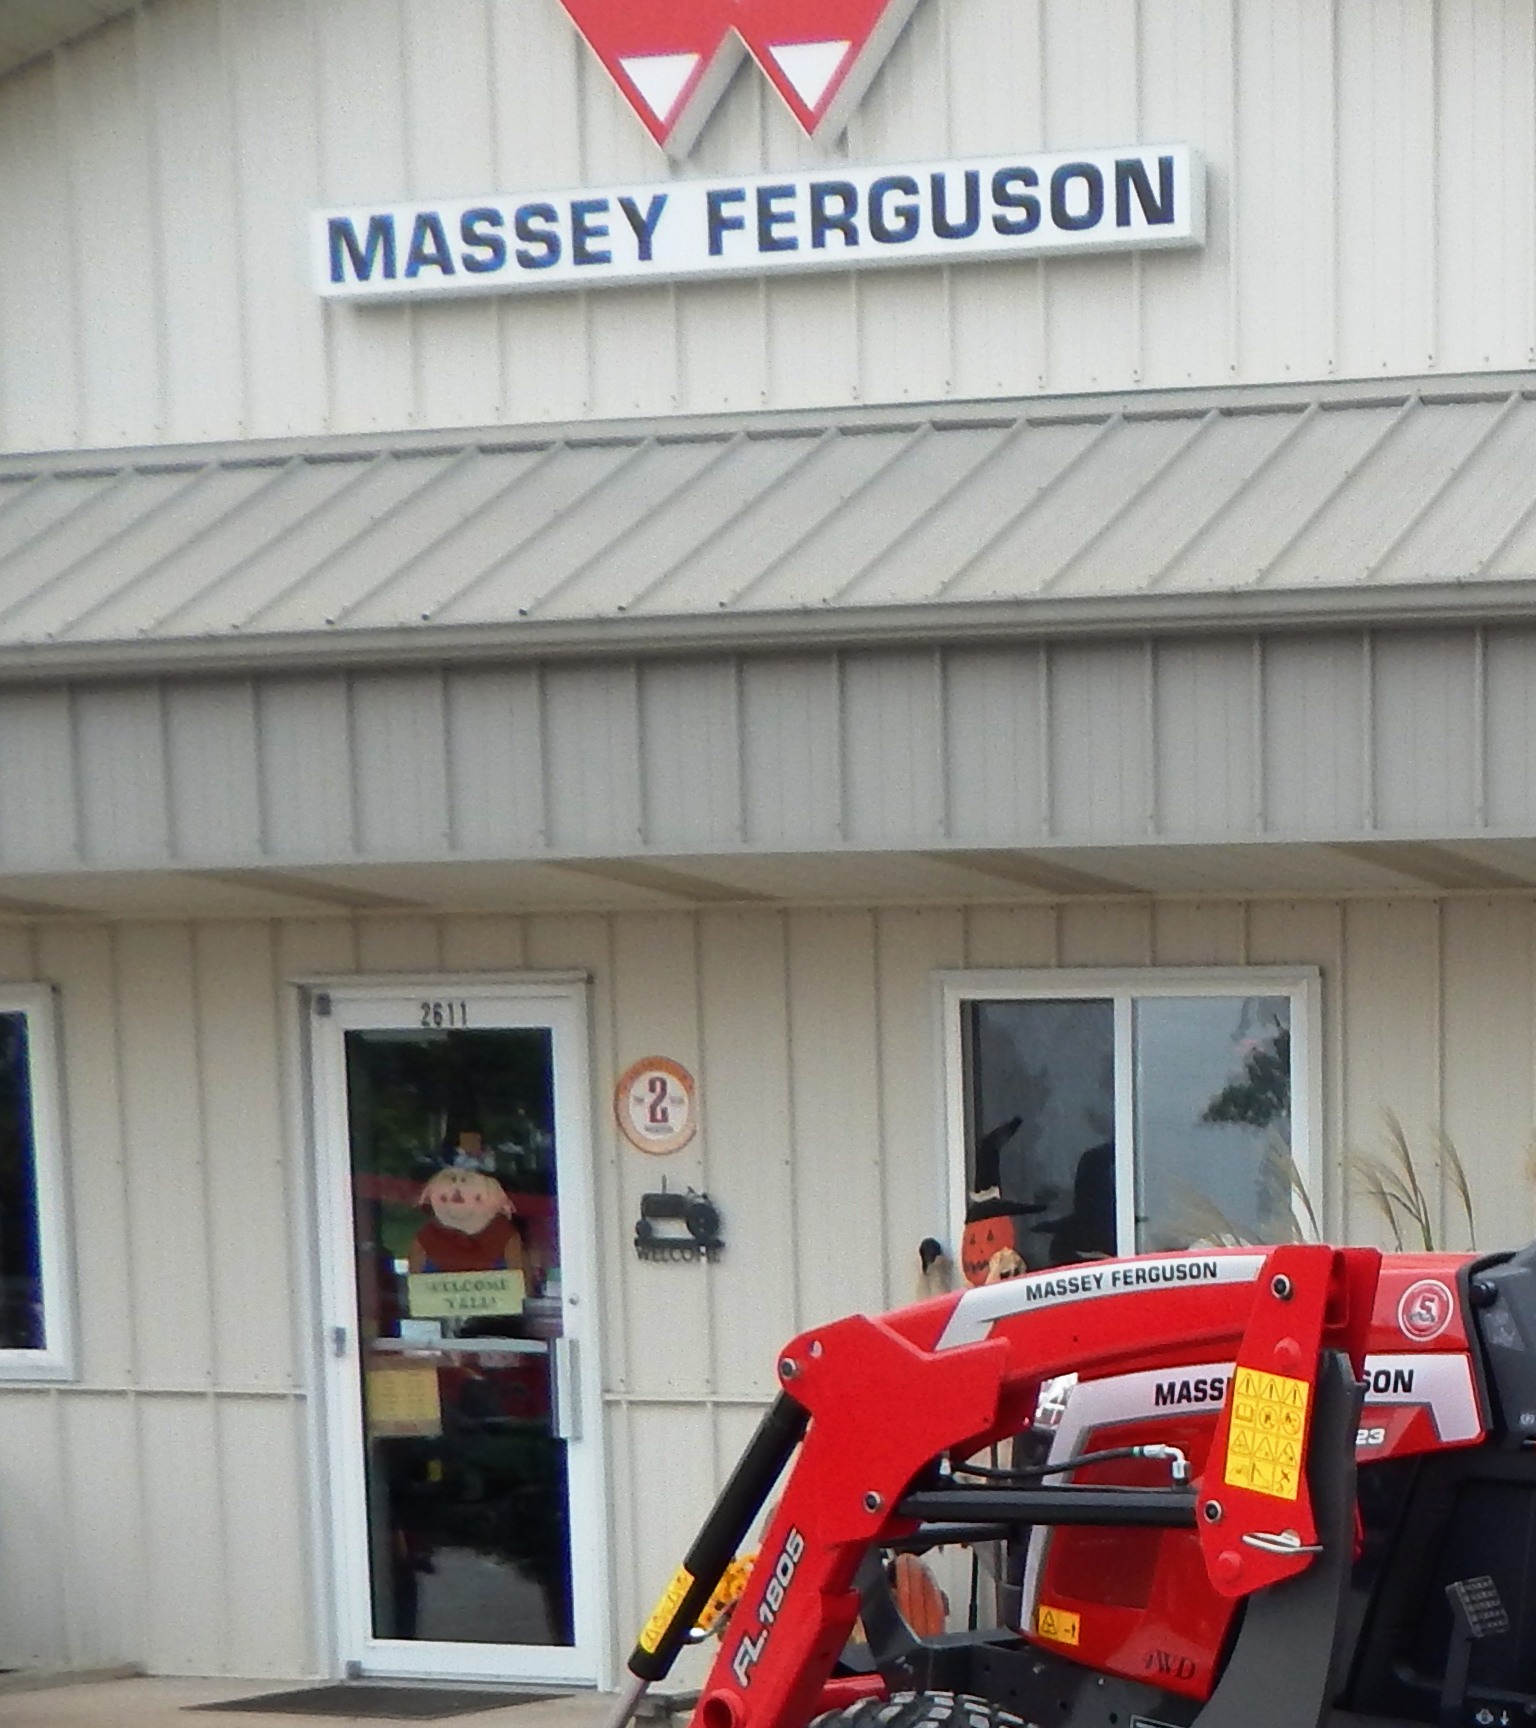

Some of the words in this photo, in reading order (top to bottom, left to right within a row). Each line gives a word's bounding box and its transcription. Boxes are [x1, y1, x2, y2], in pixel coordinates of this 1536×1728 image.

[327, 193, 668, 283] MASSEY
[706, 155, 1177, 256] FERGUSON
[421, 1001, 467, 1027] 2611
[647, 1076, 669, 1123] 2
[636, 1245, 722, 1263] WELCOME
[1025, 1271, 1104, 1301] MASSEY
[1111, 1261, 1218, 1288] FERGUSON
[732, 1525, 806, 1689] FL.1805
